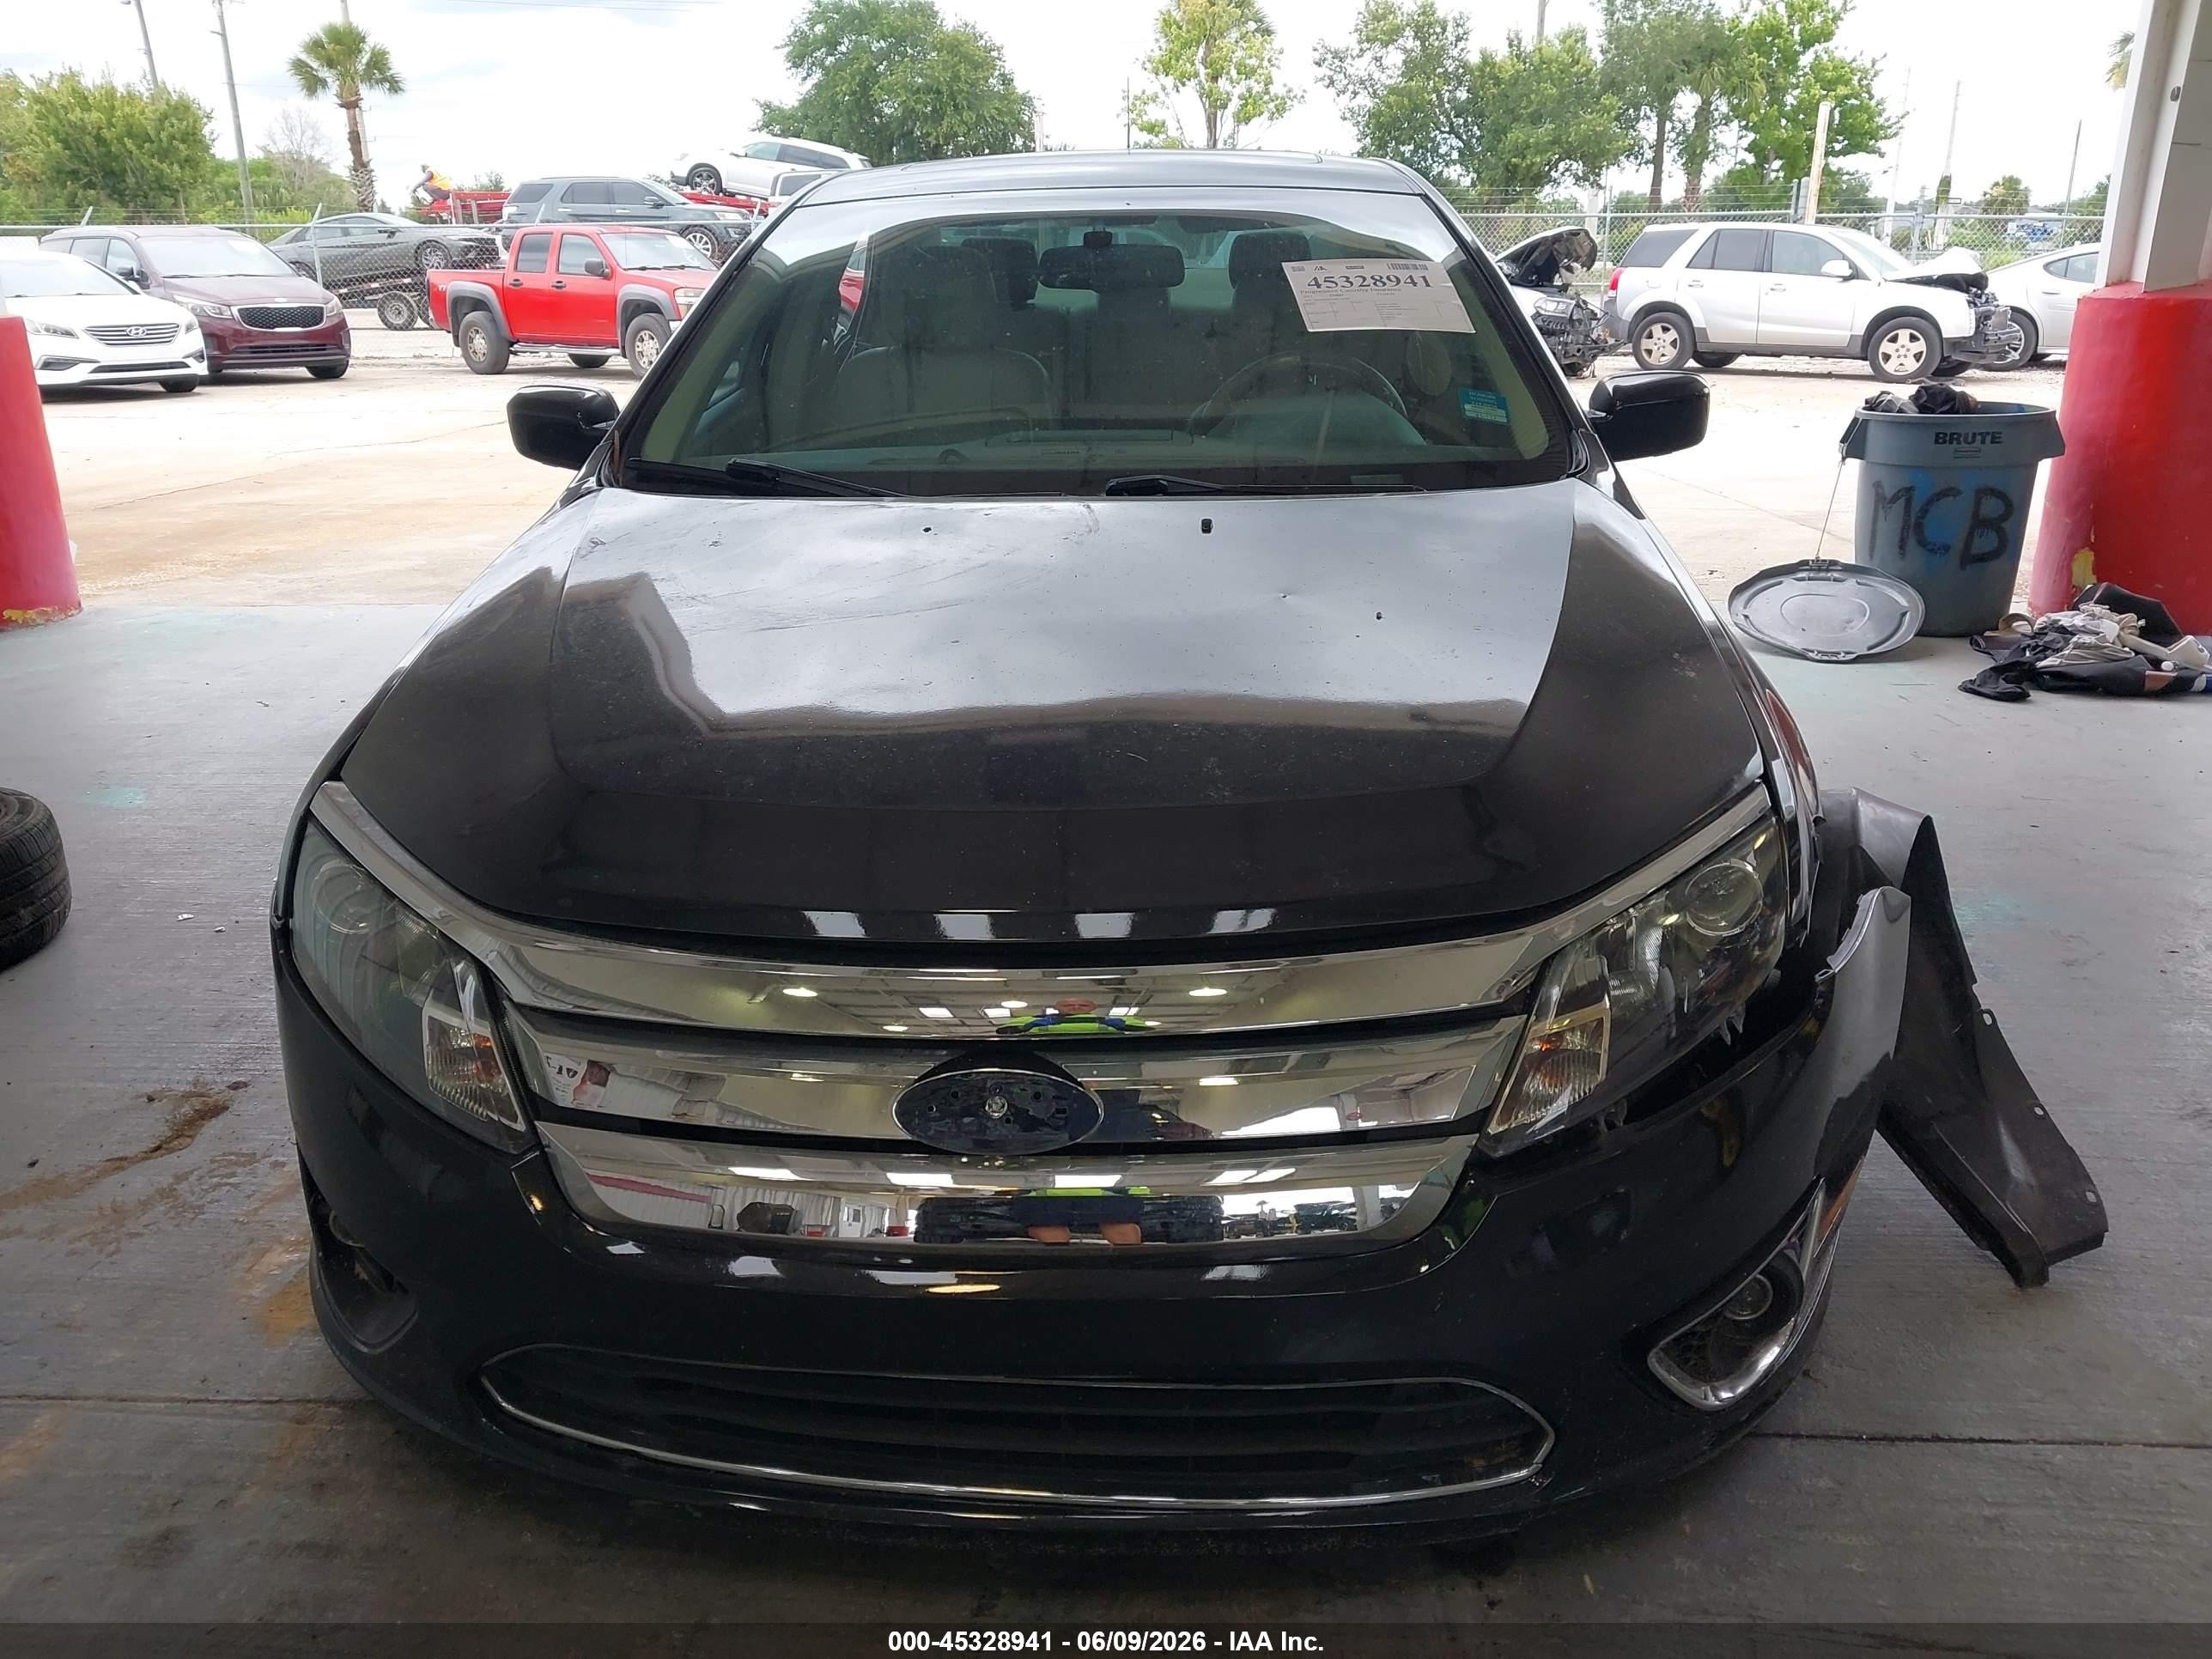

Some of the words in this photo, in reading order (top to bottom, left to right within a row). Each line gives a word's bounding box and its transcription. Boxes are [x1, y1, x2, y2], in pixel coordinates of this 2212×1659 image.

[1307, 274, 1433, 289] 45328941
[1934, 431, 2002, 445] BRUTE
[1869, 480, 2014, 570] MCB
